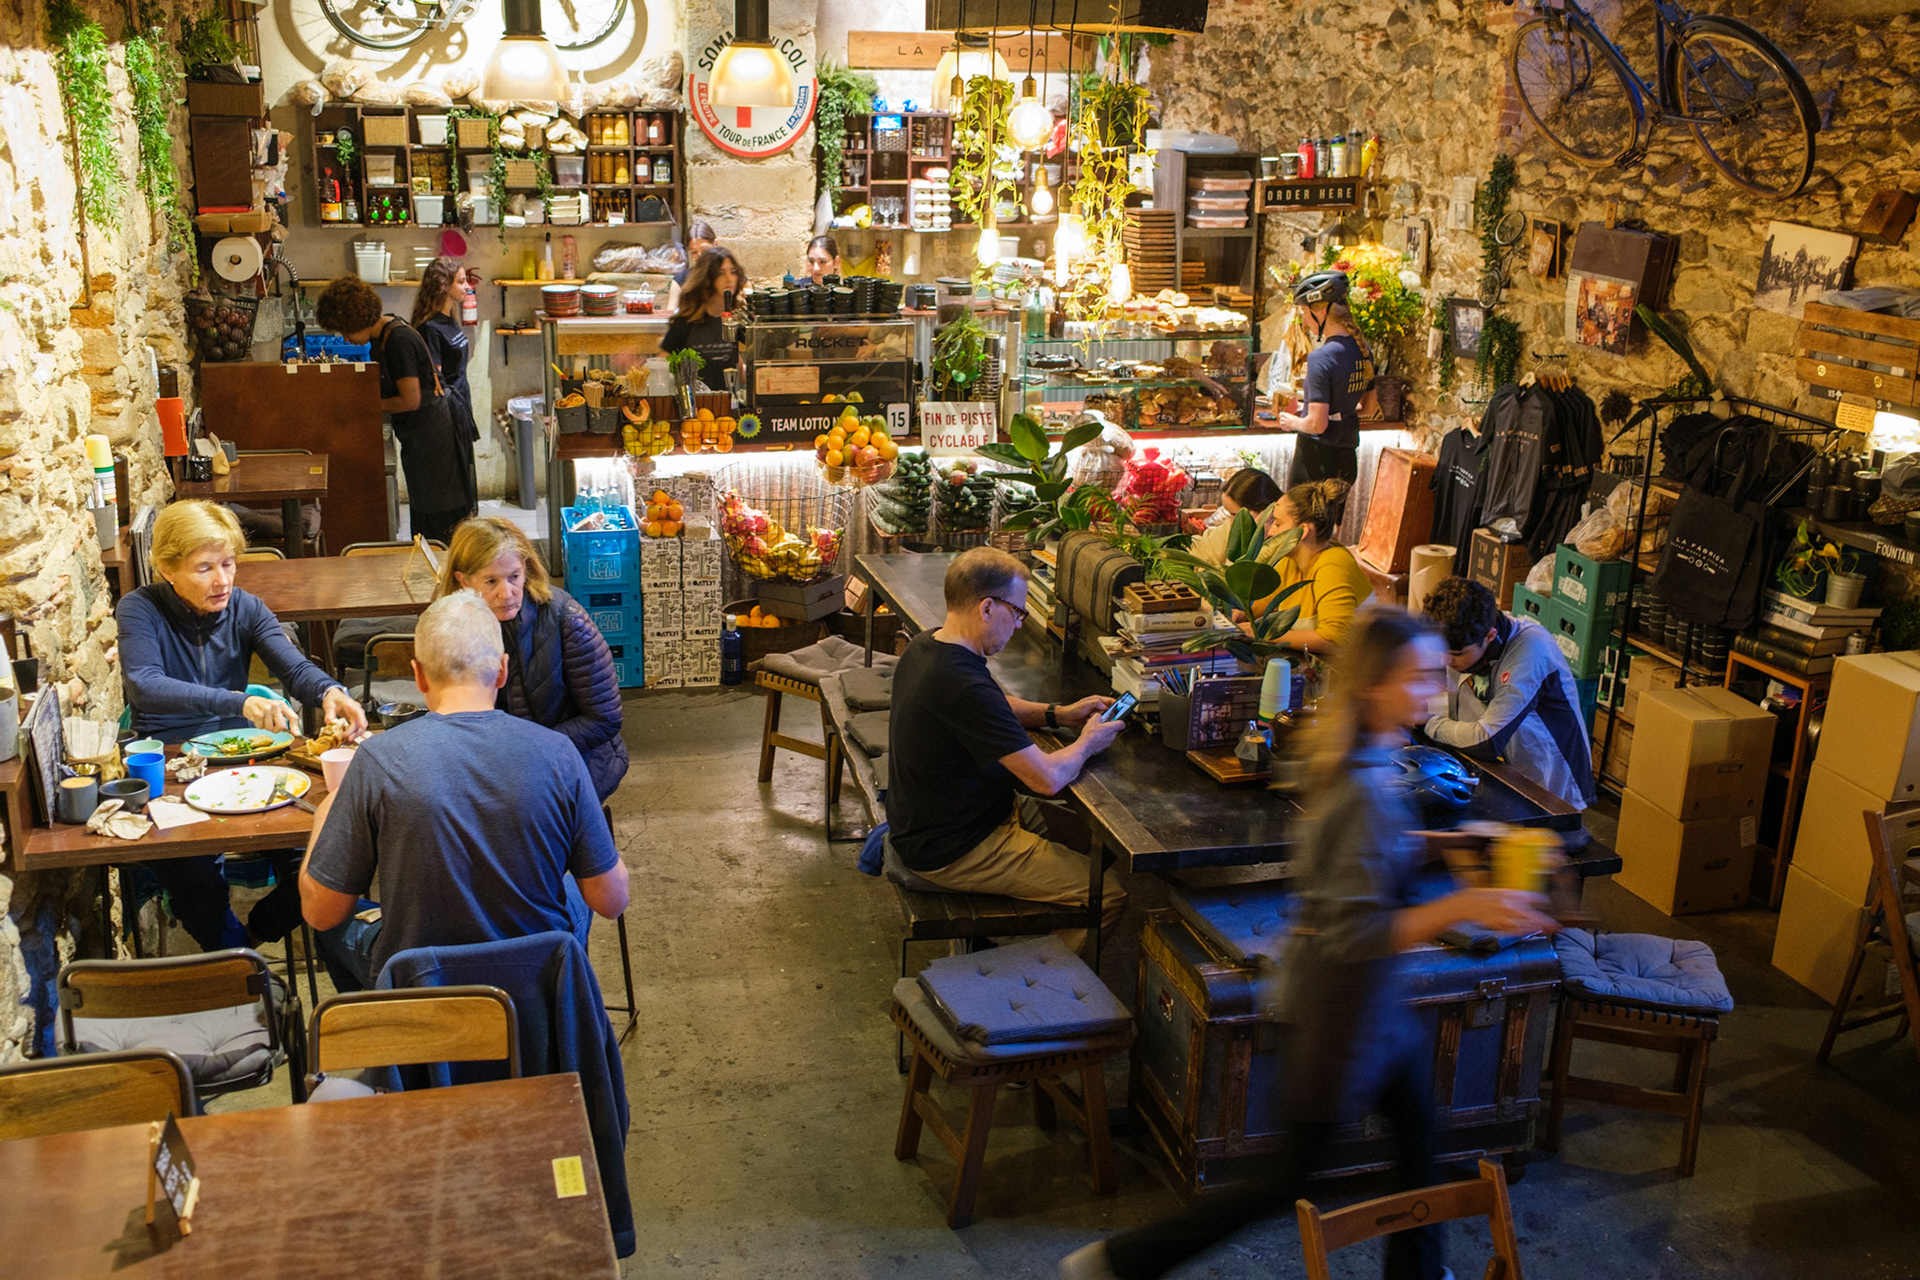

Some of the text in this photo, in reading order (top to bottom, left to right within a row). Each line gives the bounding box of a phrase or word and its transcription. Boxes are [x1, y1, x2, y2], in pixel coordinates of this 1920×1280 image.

[780, 39, 807, 73] COL
[898, 45, 923, 56] LA
[718, 124, 788, 147] TOUR DE FRANCE
[1267, 187, 1352, 201] ORDER HERE
[795, 336, 869, 349] ROCKET
[771, 418, 798, 432] TEAM
[799, 416, 831, 431] LOTTO
[891, 411, 905, 428] 15
[924, 412, 993, 426] FIN DE PISTE
[929, 434, 989, 448] CYCLABLE
[1874, 541, 1915, 565] FOUNTAIN
[592, 560, 617, 569] Font
